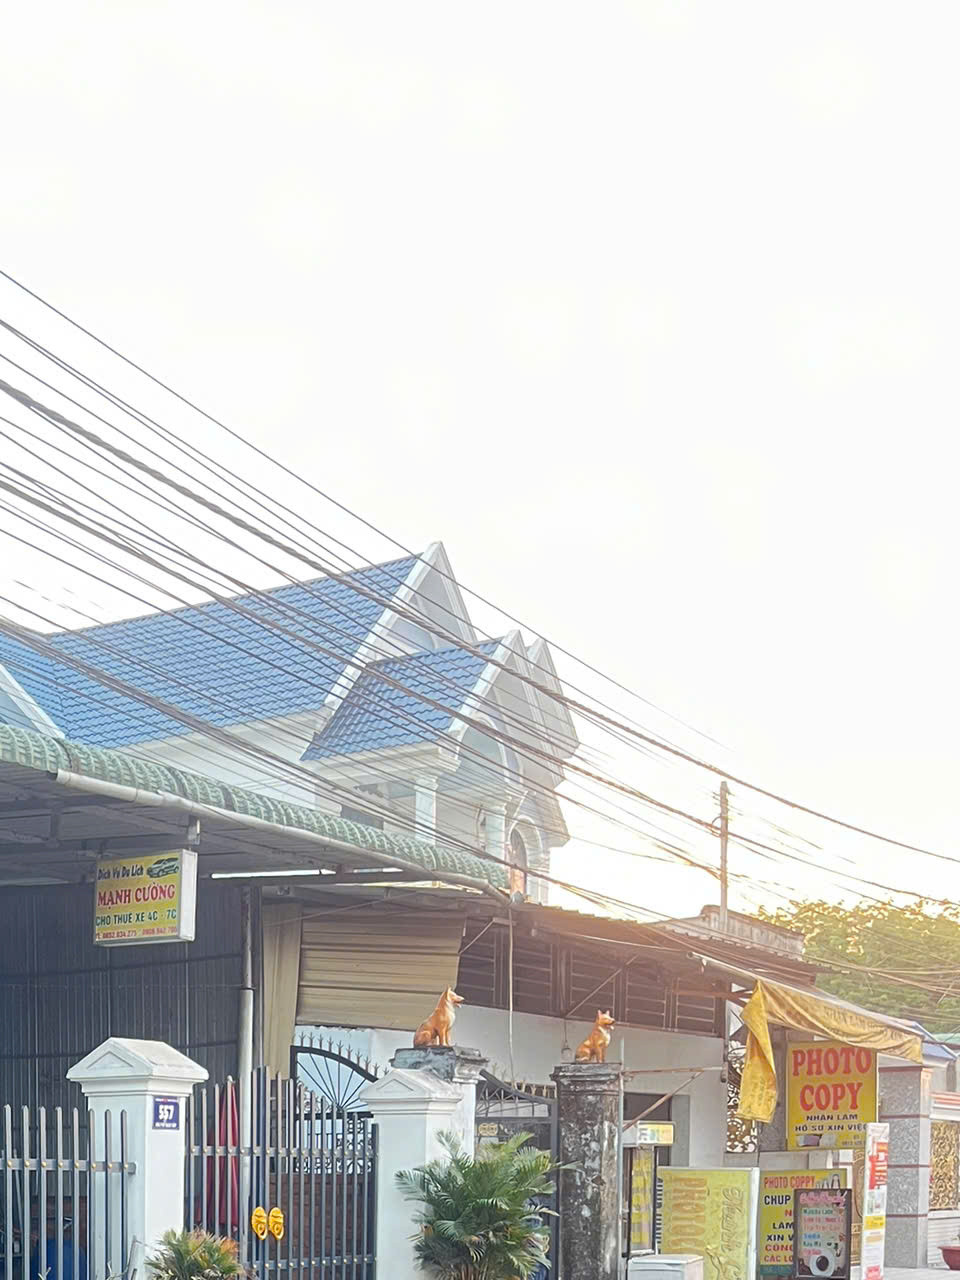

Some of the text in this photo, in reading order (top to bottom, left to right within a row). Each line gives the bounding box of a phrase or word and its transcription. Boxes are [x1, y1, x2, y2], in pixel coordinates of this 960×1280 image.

[98, 889, 131, 909] MẠNH
[96, 916, 111, 926] CHO
[135, 911, 145, 922] XE
[148, 910, 158, 921] 4C
[167, 909, 177, 919] 7C
[792, 1047, 872, 1076] PHOTO
[800, 1082, 863, 1111] COPY
[764, 1176, 815, 1189] PHOTO COPPY
